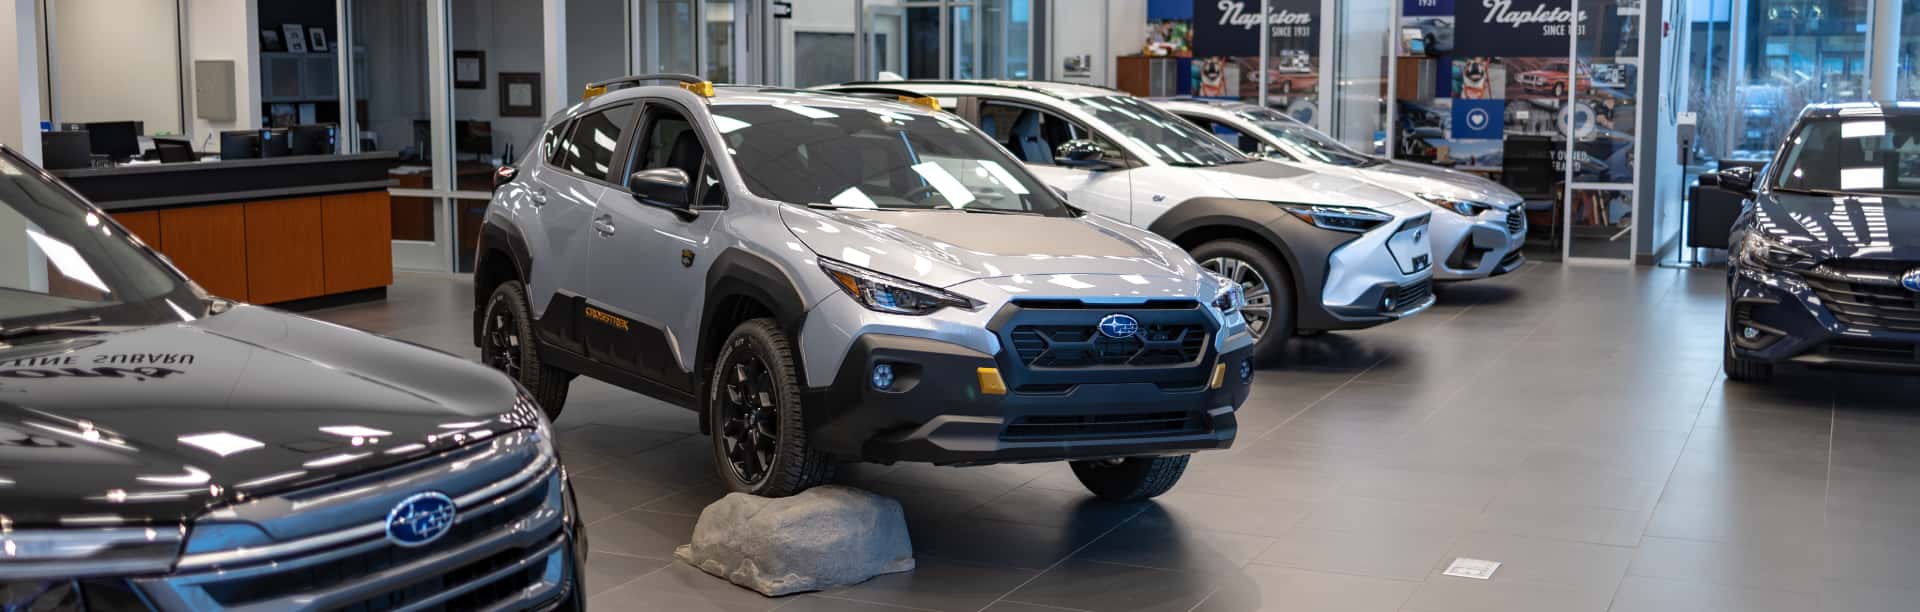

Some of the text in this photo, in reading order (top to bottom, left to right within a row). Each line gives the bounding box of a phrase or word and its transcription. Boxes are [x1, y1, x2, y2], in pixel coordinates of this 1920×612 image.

[1217, 0, 1311, 29] Napeton
[1271, 26, 1310, 37] SINCE 1931
[1542, 24, 1585, 36] SINCE 131
